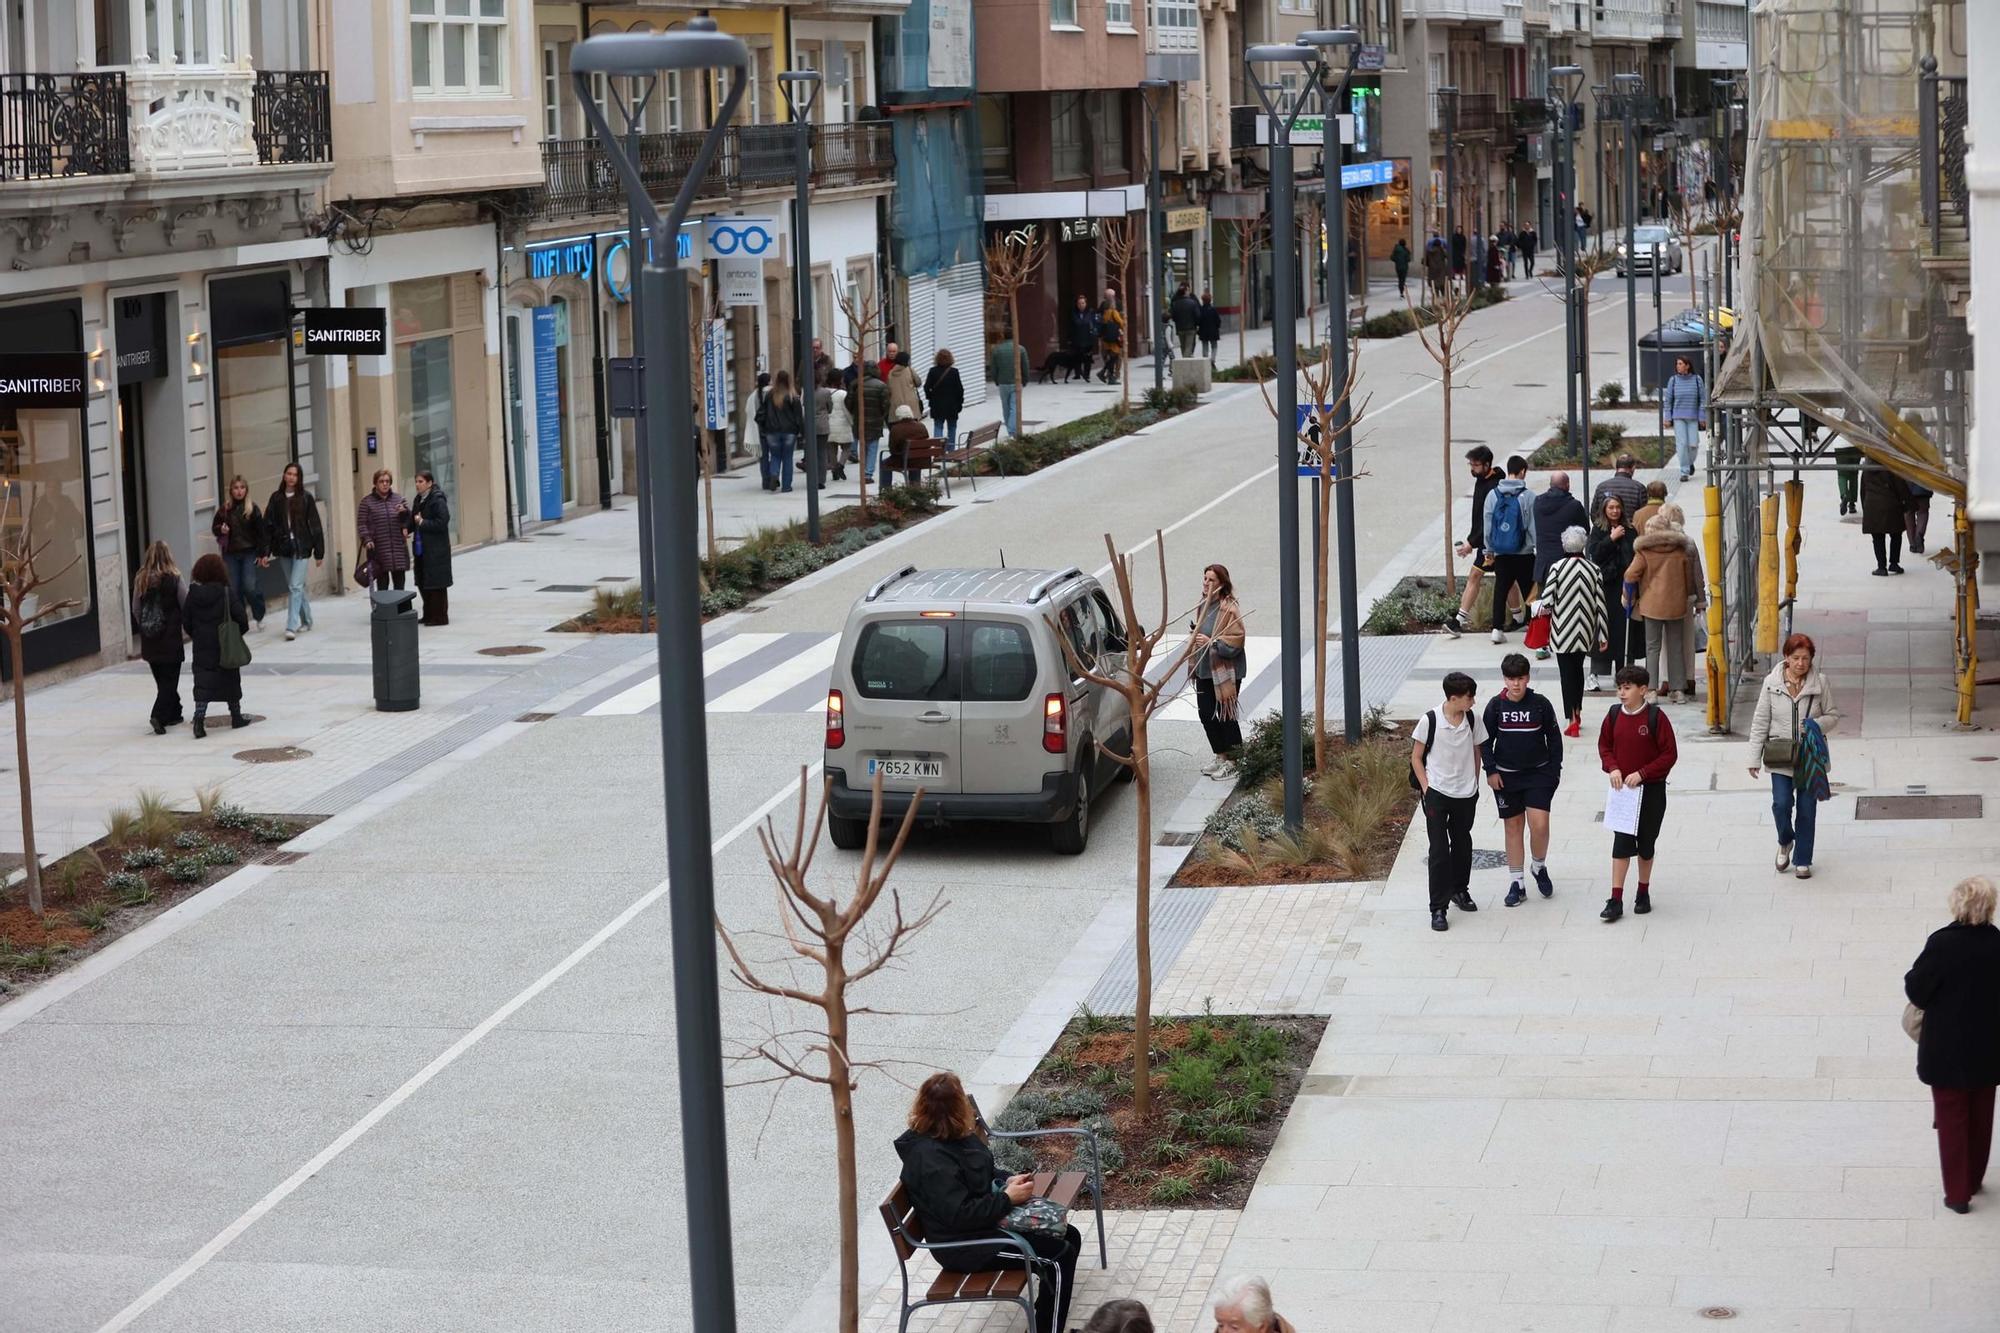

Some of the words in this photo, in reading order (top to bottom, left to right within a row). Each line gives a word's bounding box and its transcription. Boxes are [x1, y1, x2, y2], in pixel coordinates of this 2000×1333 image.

[530, 243, 593, 280] INFINITY
[307, 329, 381, 342] SANITRIBER
[116, 350, 151, 368] ANITRIBER
[0, 378, 82, 394] SANITRIBER
[1502, 711, 1531, 722] FSM
[878, 761, 910, 775] 7652
[914, 762, 939, 776] KWN
